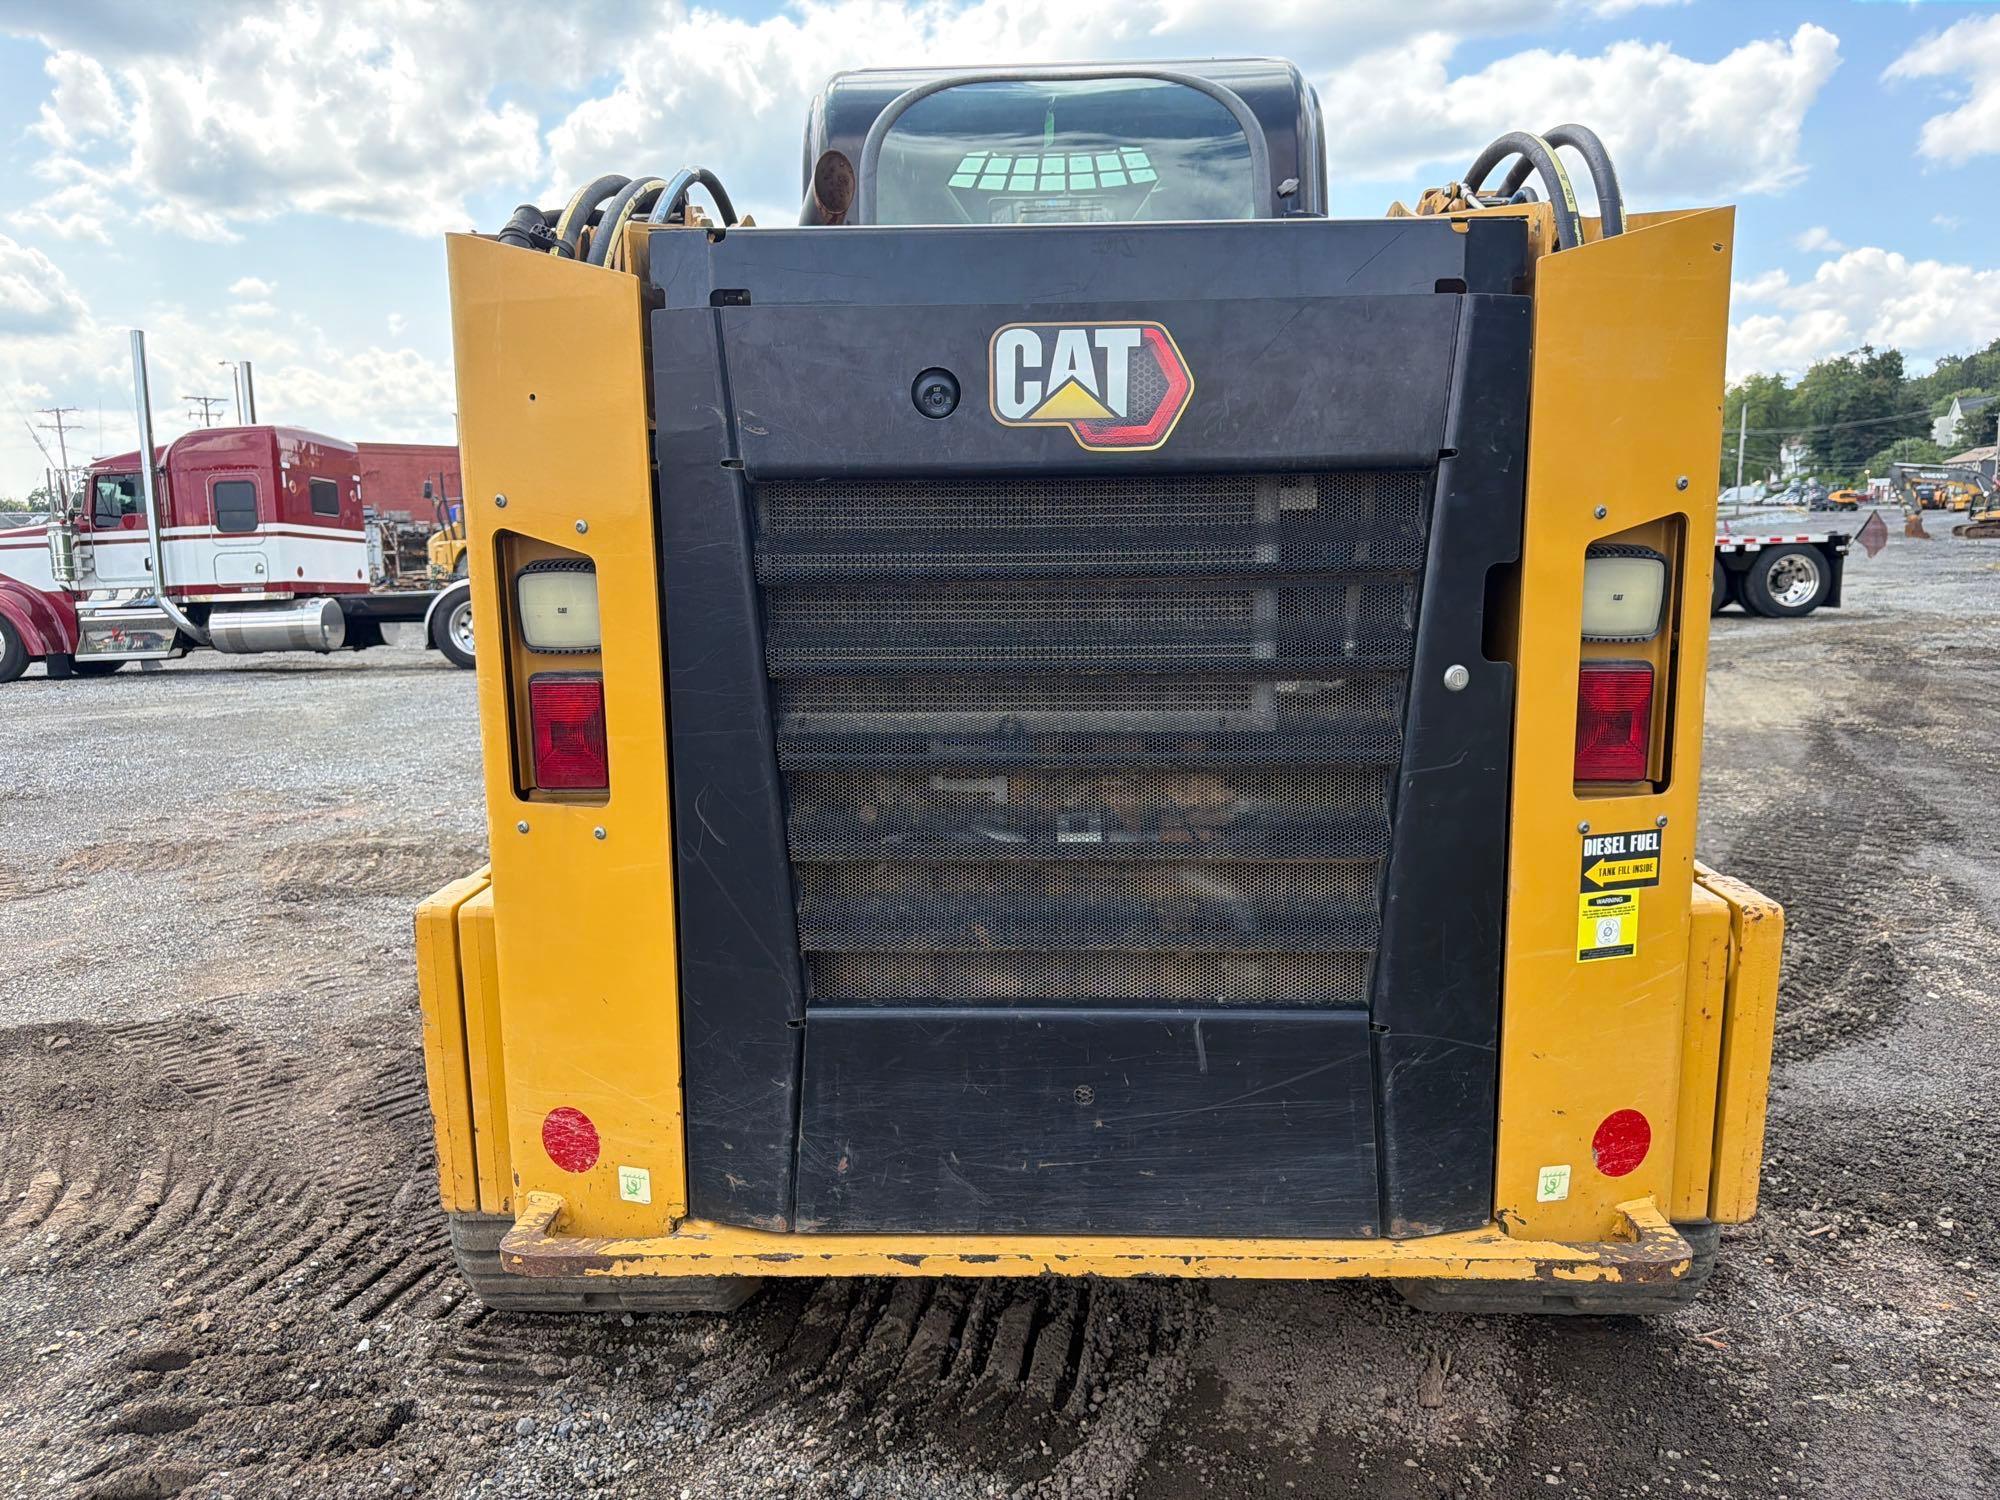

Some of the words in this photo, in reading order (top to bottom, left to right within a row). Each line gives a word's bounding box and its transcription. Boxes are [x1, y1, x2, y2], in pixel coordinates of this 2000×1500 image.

[996, 328, 1142, 419] CAT
[1584, 836, 1626, 856] DIESEL
[1630, 833, 1659, 852] FUEL
[1599, 867, 1615, 876] TANK
[1618, 865, 1630, 875] FILL
[1632, 863, 1653, 873] INSIDE
